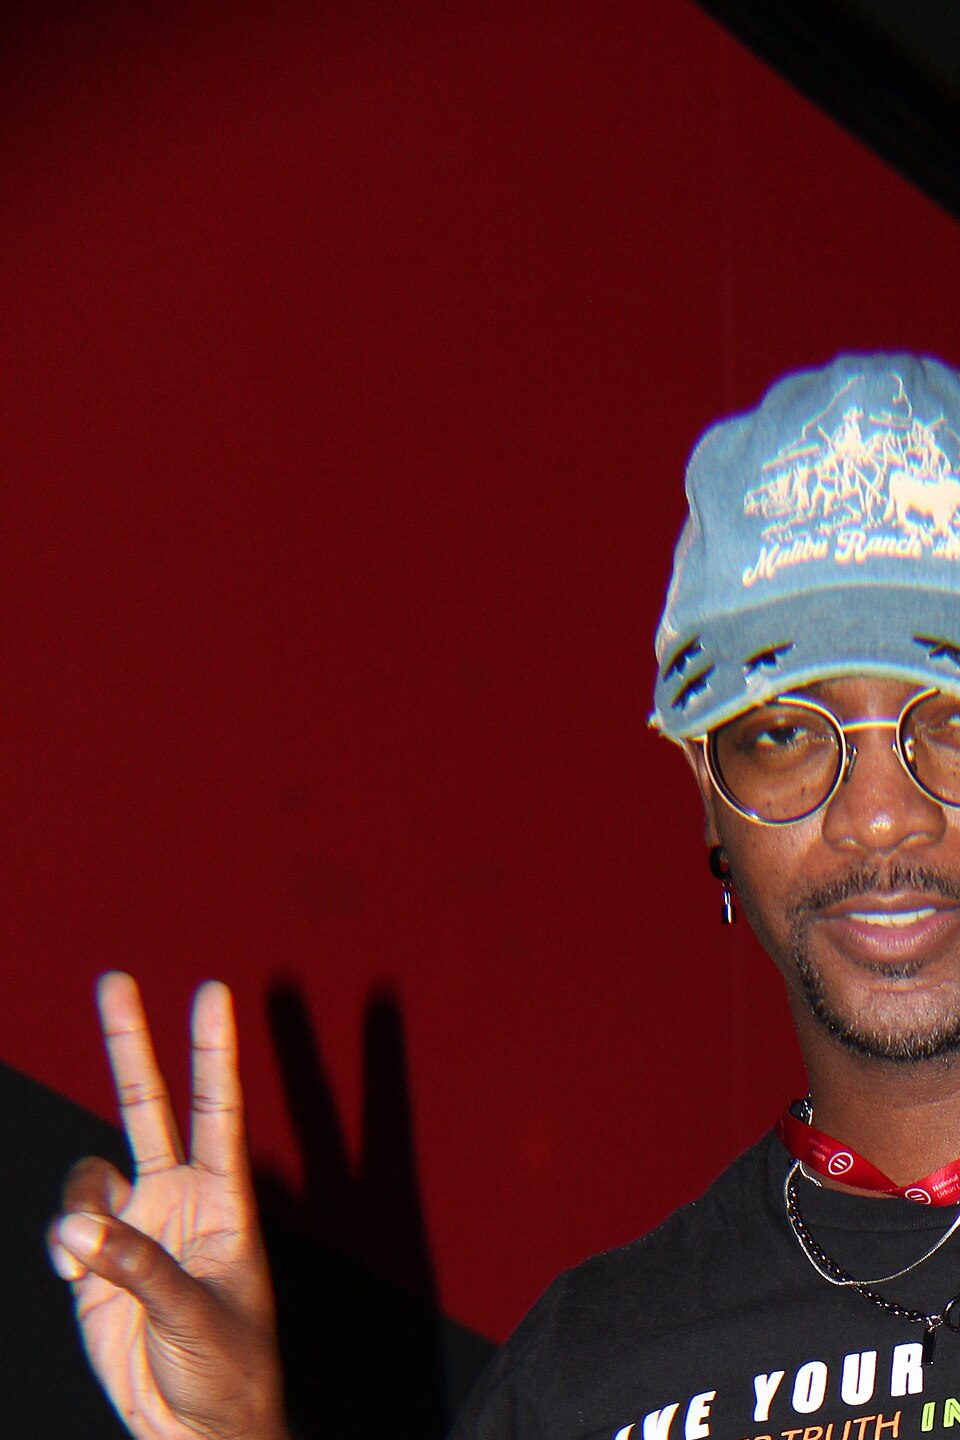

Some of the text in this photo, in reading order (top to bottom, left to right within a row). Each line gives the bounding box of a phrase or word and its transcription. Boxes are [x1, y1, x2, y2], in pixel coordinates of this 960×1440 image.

[834, 528, 922, 565] Ranch
[932, 1173, 959, 1193] National
[753, 1342, 924, 1422] YOUR
